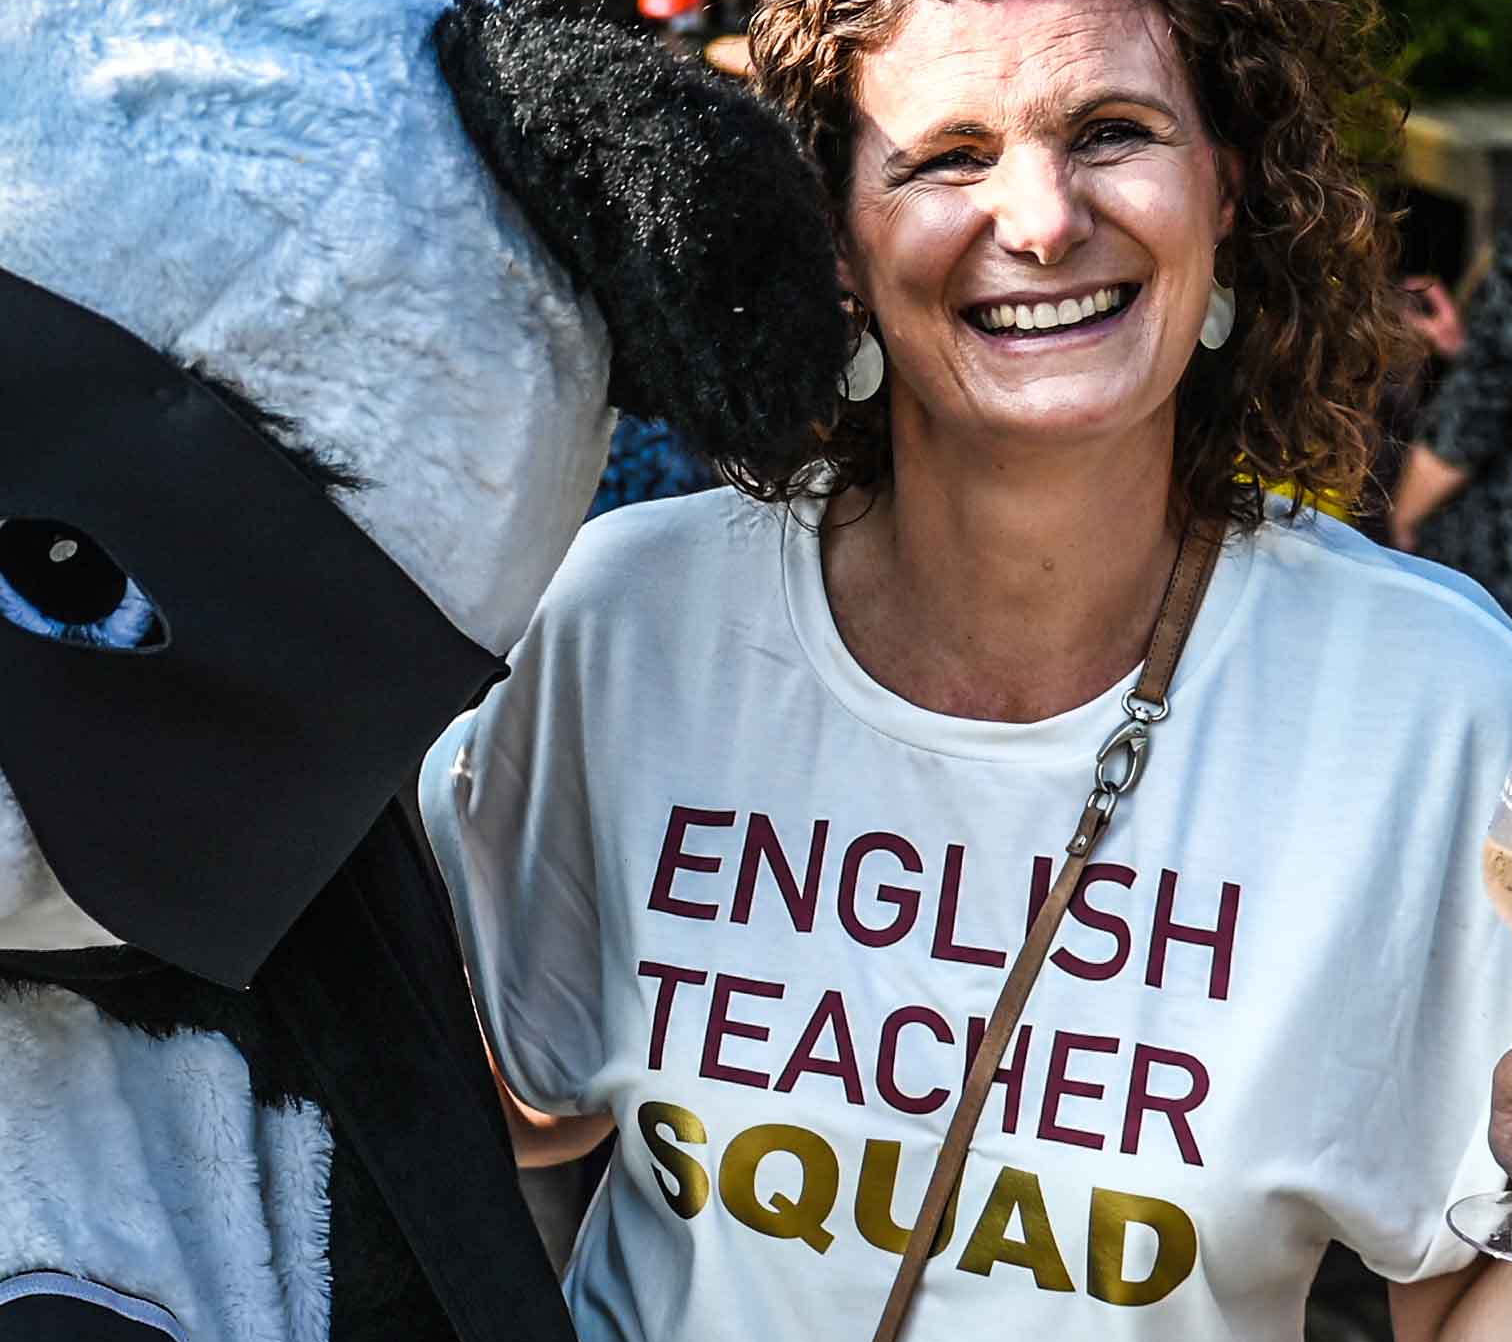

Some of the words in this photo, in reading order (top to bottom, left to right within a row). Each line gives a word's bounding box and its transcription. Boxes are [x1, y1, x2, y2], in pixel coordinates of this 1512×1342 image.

[645, 804, 1241, 1001] ENGLISH
[636, 960, 1205, 1167] TEACHER
[636, 1100, 1198, 1307] SQUAD
